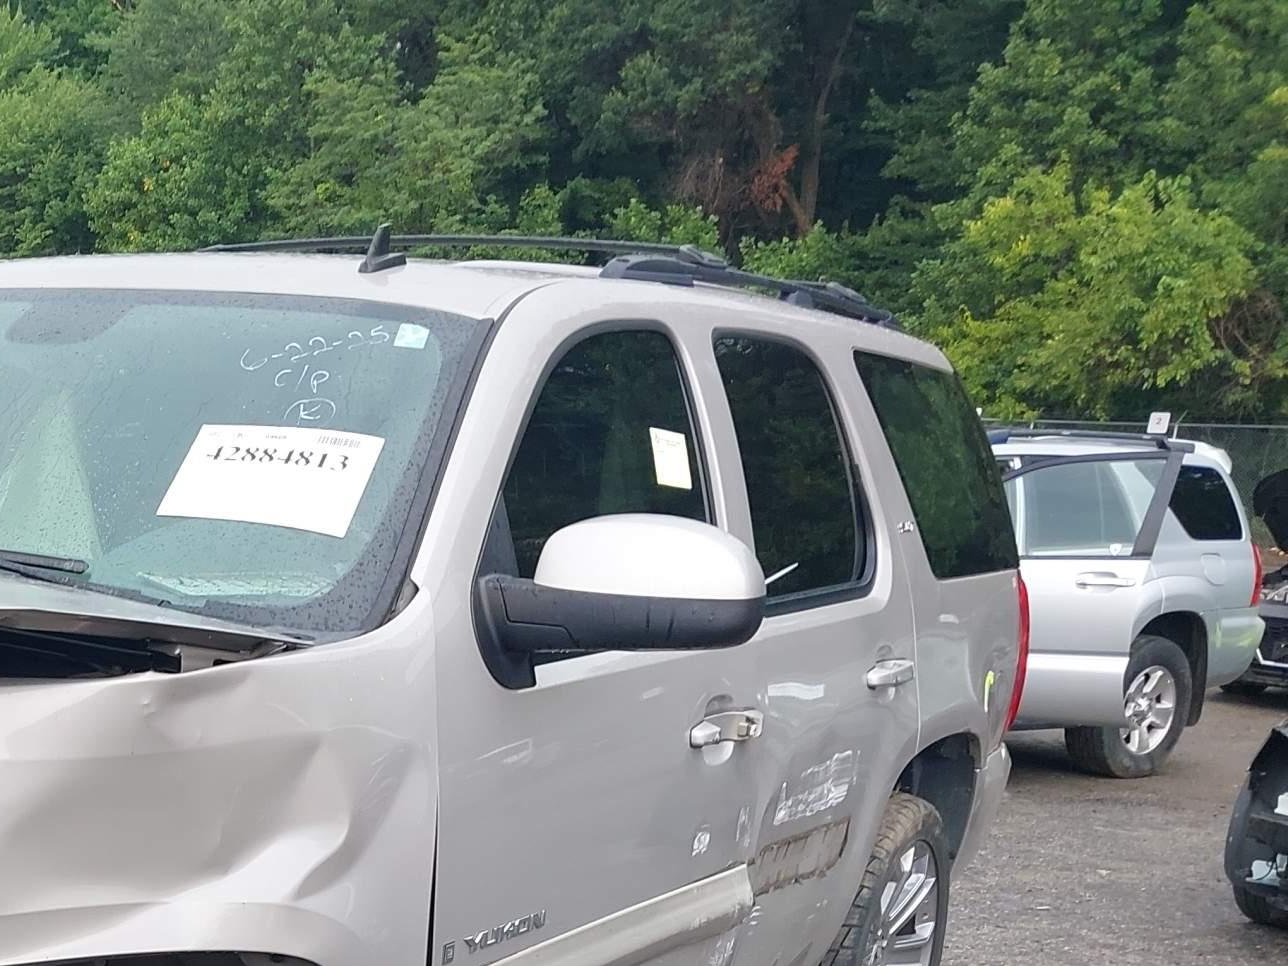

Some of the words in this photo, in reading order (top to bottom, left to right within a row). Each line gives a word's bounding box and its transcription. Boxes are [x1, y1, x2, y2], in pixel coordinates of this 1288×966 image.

[240, 325, 389, 370] 6-22-25
[206, 446, 349, 470] 42884813
[464, 909, 546, 953] YUKON
